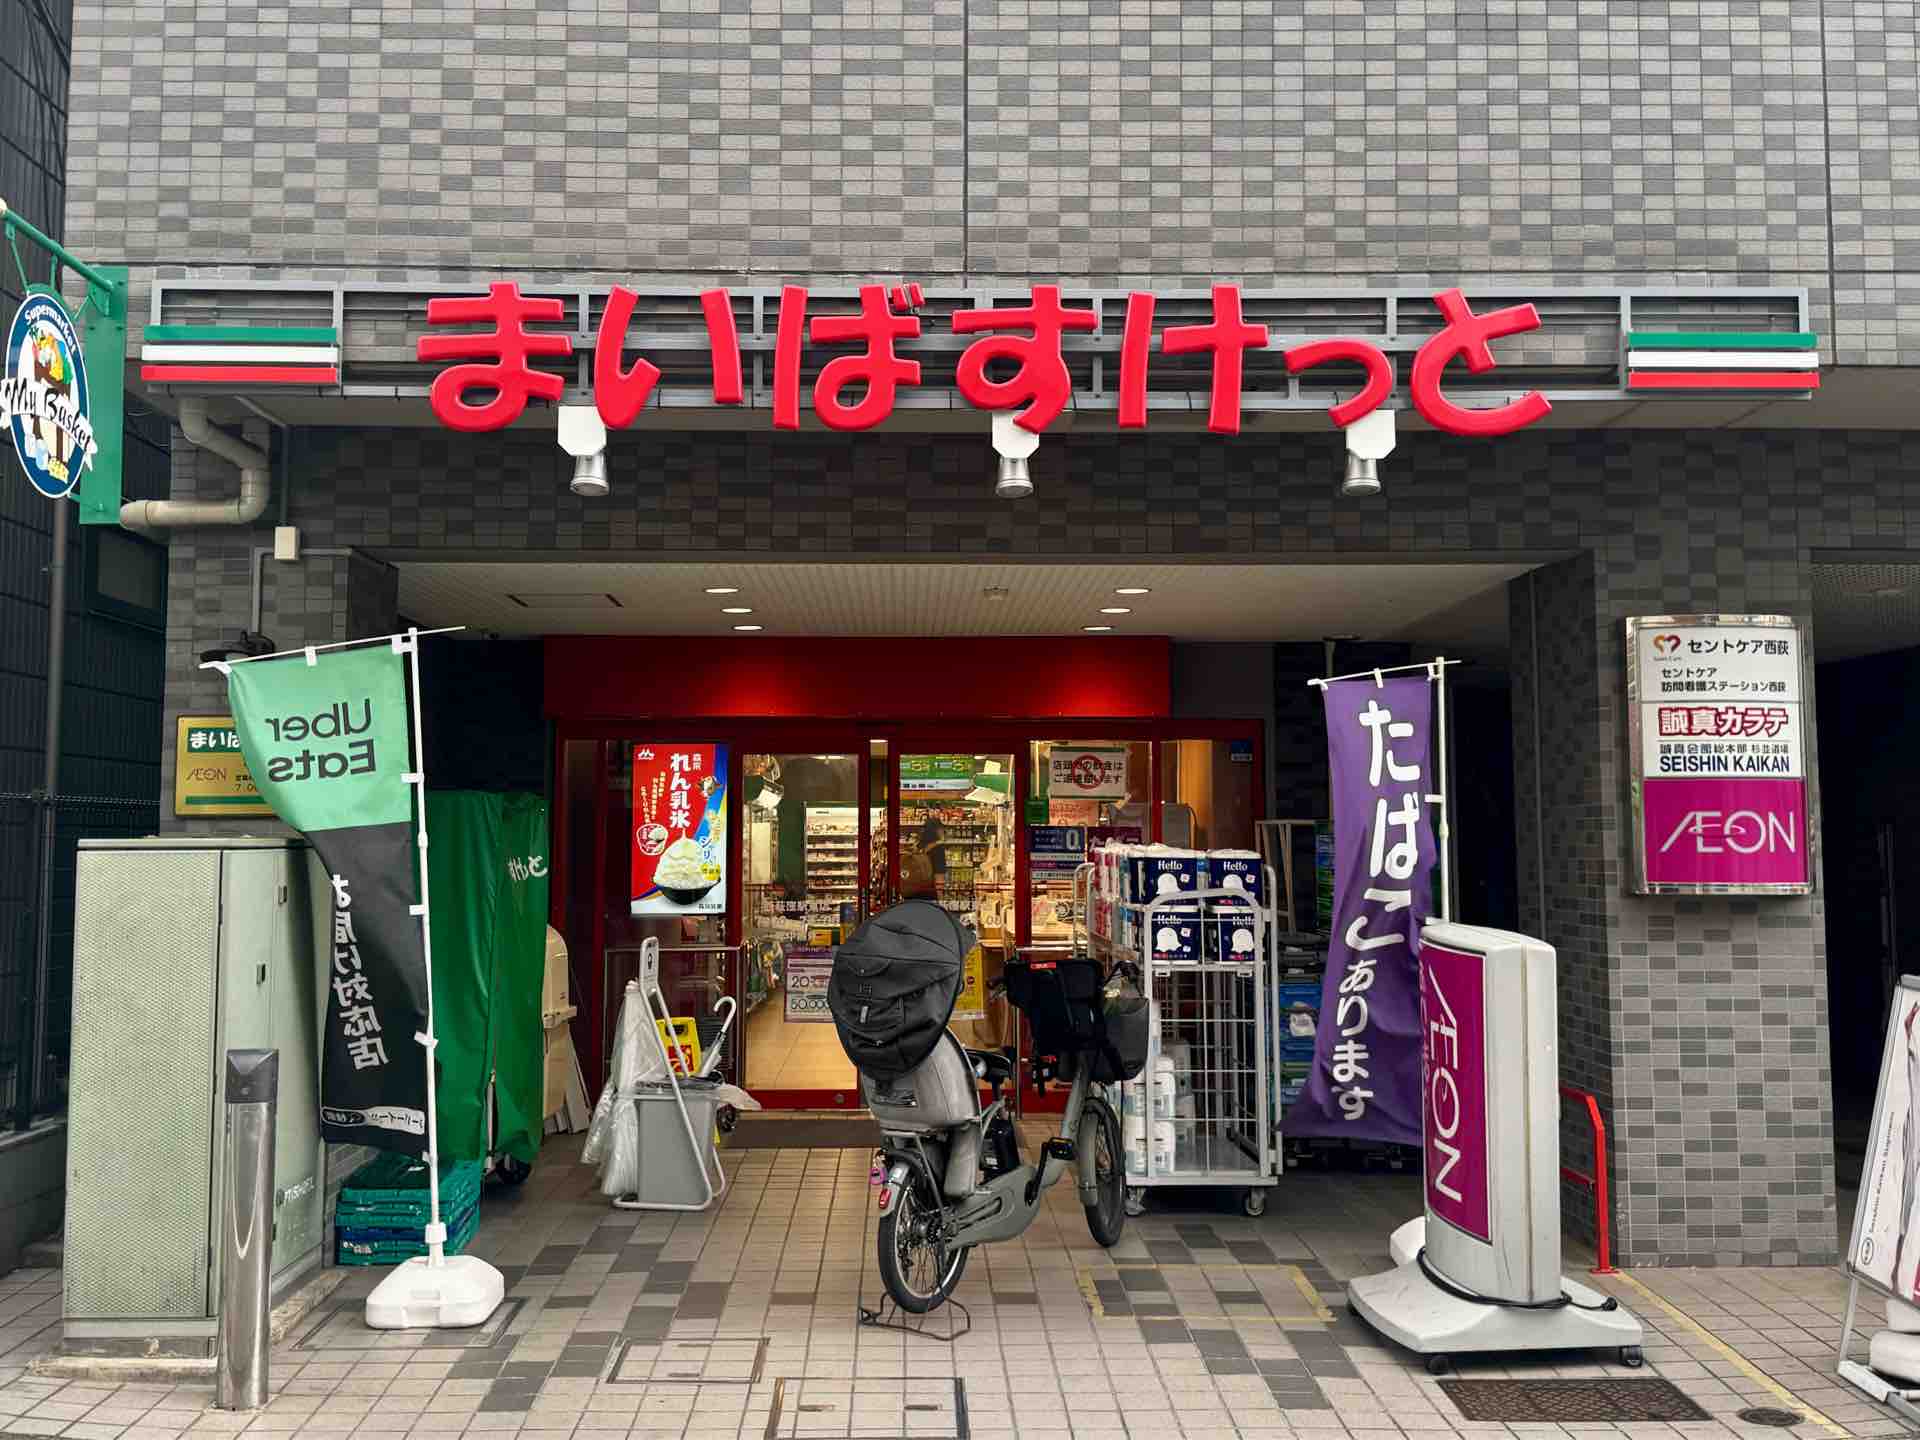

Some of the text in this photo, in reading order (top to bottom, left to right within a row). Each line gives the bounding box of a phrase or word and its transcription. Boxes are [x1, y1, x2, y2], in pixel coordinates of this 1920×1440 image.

[24, 303, 77, 353] Supermarket
[417, 281, 1552, 437] まいばすけっと
[5, 377, 91, 449] My Basket
[1687, 639, 1789, 655] セントケア西荻
[1661, 667, 1717, 678] セントケア
[1658, 706, 1789, 737] 誠真カラテ
[1660, 755, 1790, 772] SEISHIN KAIKAN
[670, 753, 691, 828] れん乳氷
[1157, 860, 1183, 871] Hello
[1223, 861, 1249, 872] Hello
[1156, 914, 1182, 925] Hello
